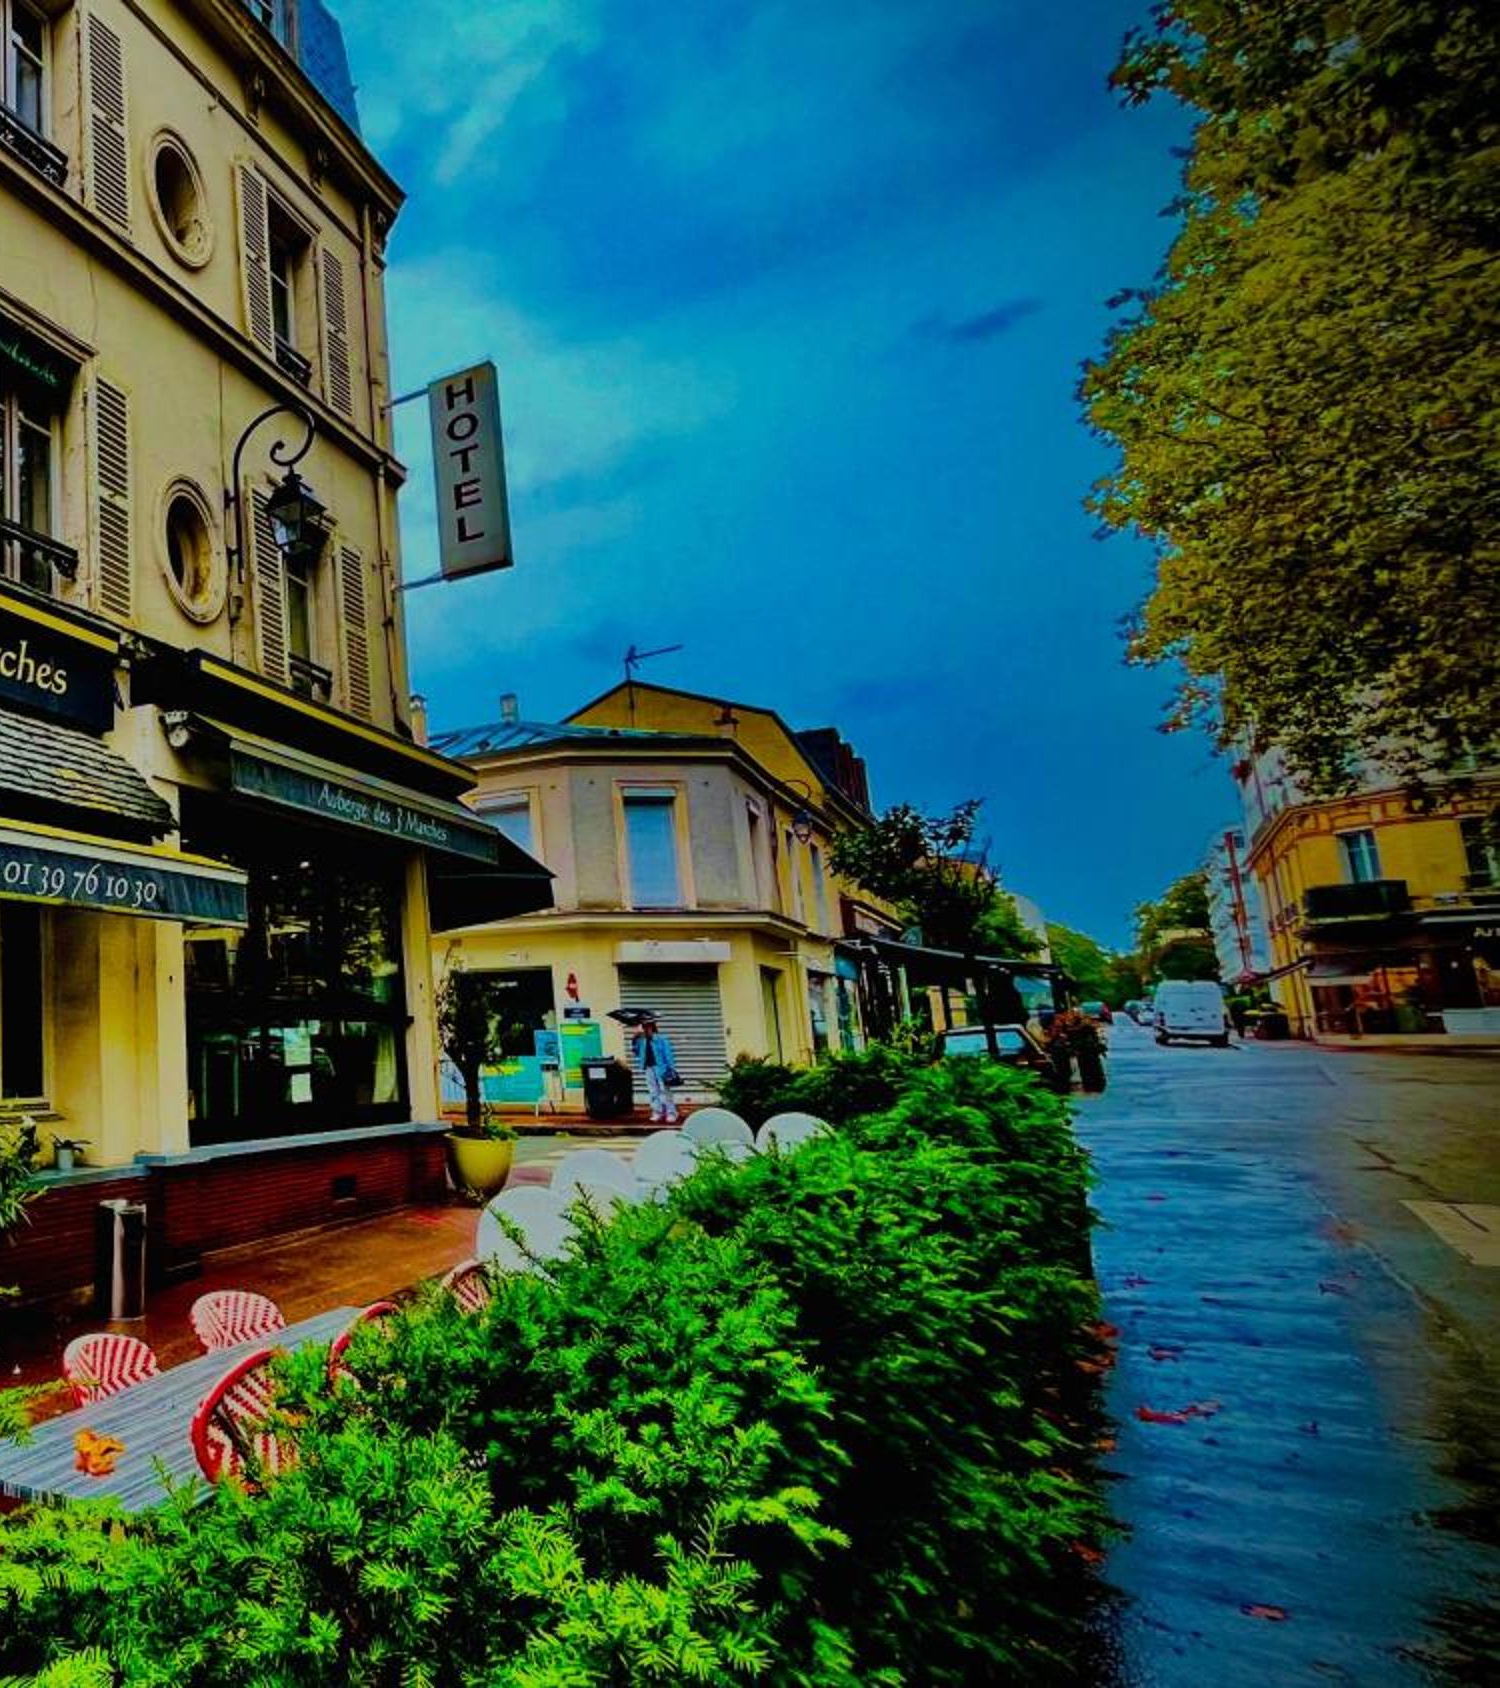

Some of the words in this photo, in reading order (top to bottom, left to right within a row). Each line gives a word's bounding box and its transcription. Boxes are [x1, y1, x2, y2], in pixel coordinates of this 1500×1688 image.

[445, 377, 484, 543] HOTEL
[317, 782, 368, 821] Auberge
[373, 801, 391, 825] des
[405, 810, 448, 841] Marches
[3, 861, 34, 886] 01
[36, 866, 65, 897] 39
[71, 863, 102, 900] 76
[105, 876, 129, 900] 10
[131, 881, 157, 907] 30
